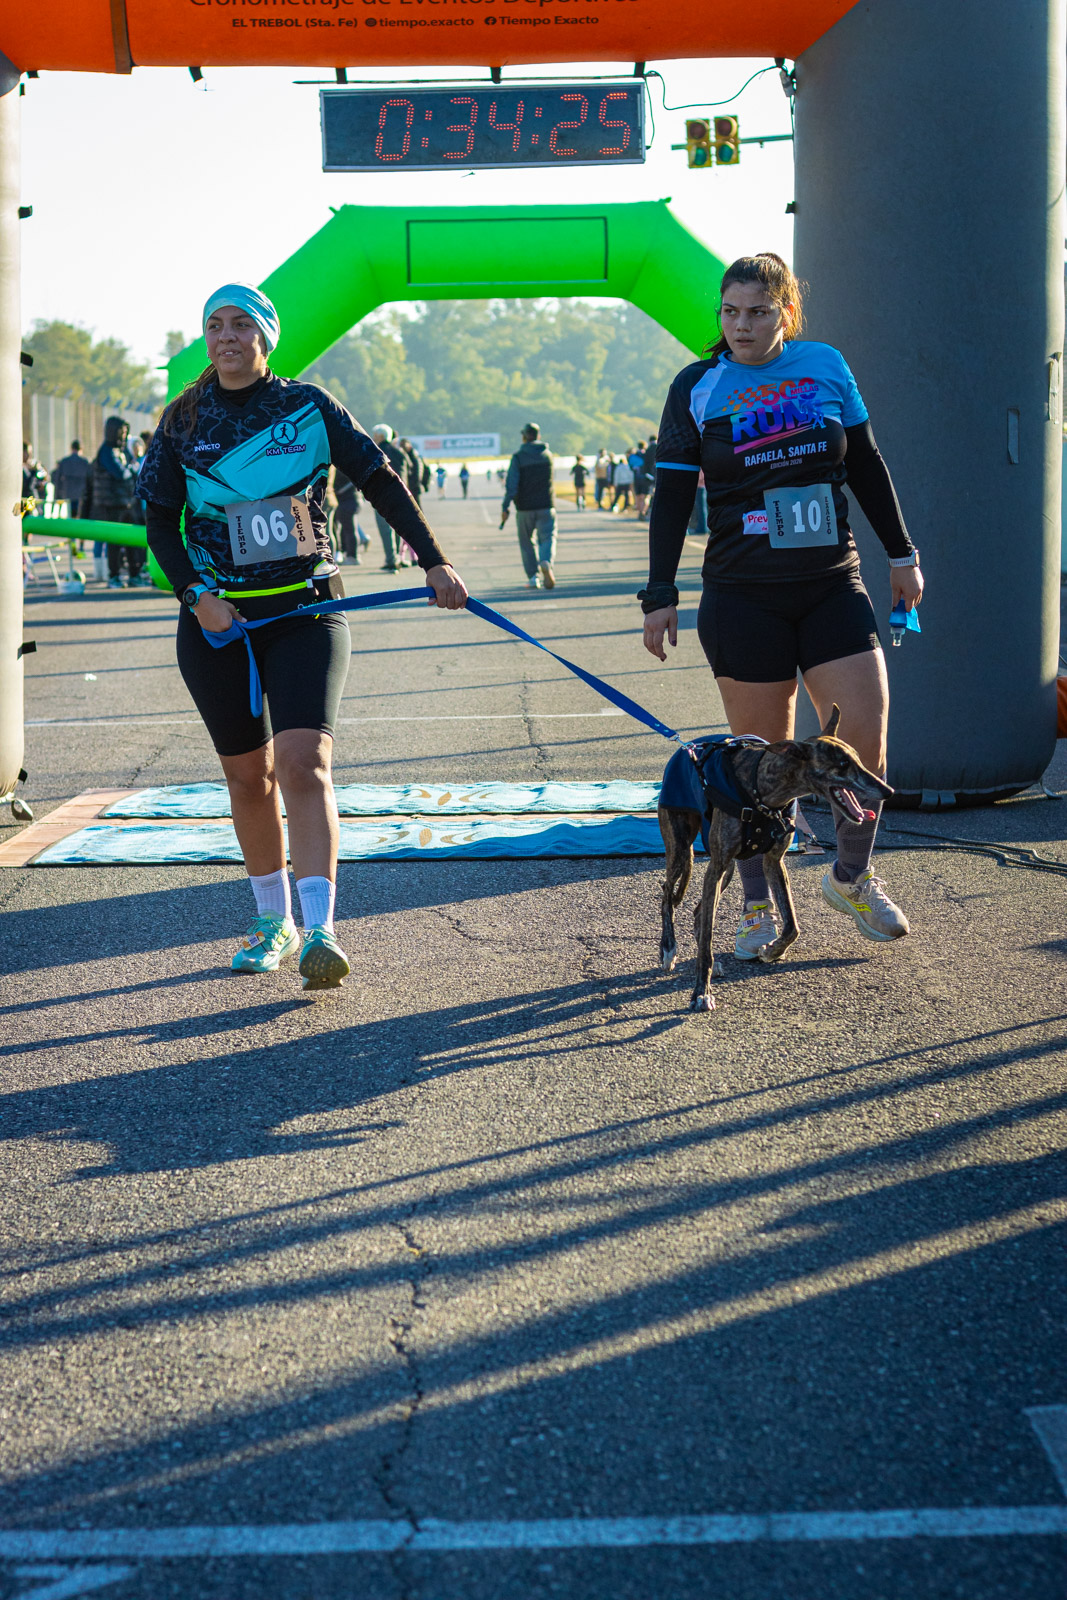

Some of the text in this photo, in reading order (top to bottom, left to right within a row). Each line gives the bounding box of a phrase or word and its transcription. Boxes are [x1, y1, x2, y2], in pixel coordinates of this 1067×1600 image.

[232, 19, 247, 27] EL
[250, 19, 302, 27] TREBOL
[305, 18, 335, 28] (Sta.
[338, 18, 358, 28] Fe)
[499, 16, 550, 26] Tiempo
[554, 16, 599, 25] Exacto
[374, 92, 631, 161] 0:34:25
[194, 443, 221, 452] INVICTO
[283, 444, 306, 455] TEAM
[744, 441, 827, 467] RAFAELA, SANTA FE
[251, 509, 288, 547] 06
[773, 500, 784, 537] TIEMPO
[792, 500, 821, 533] 10
[235, 515, 247, 555] TIEMPO
